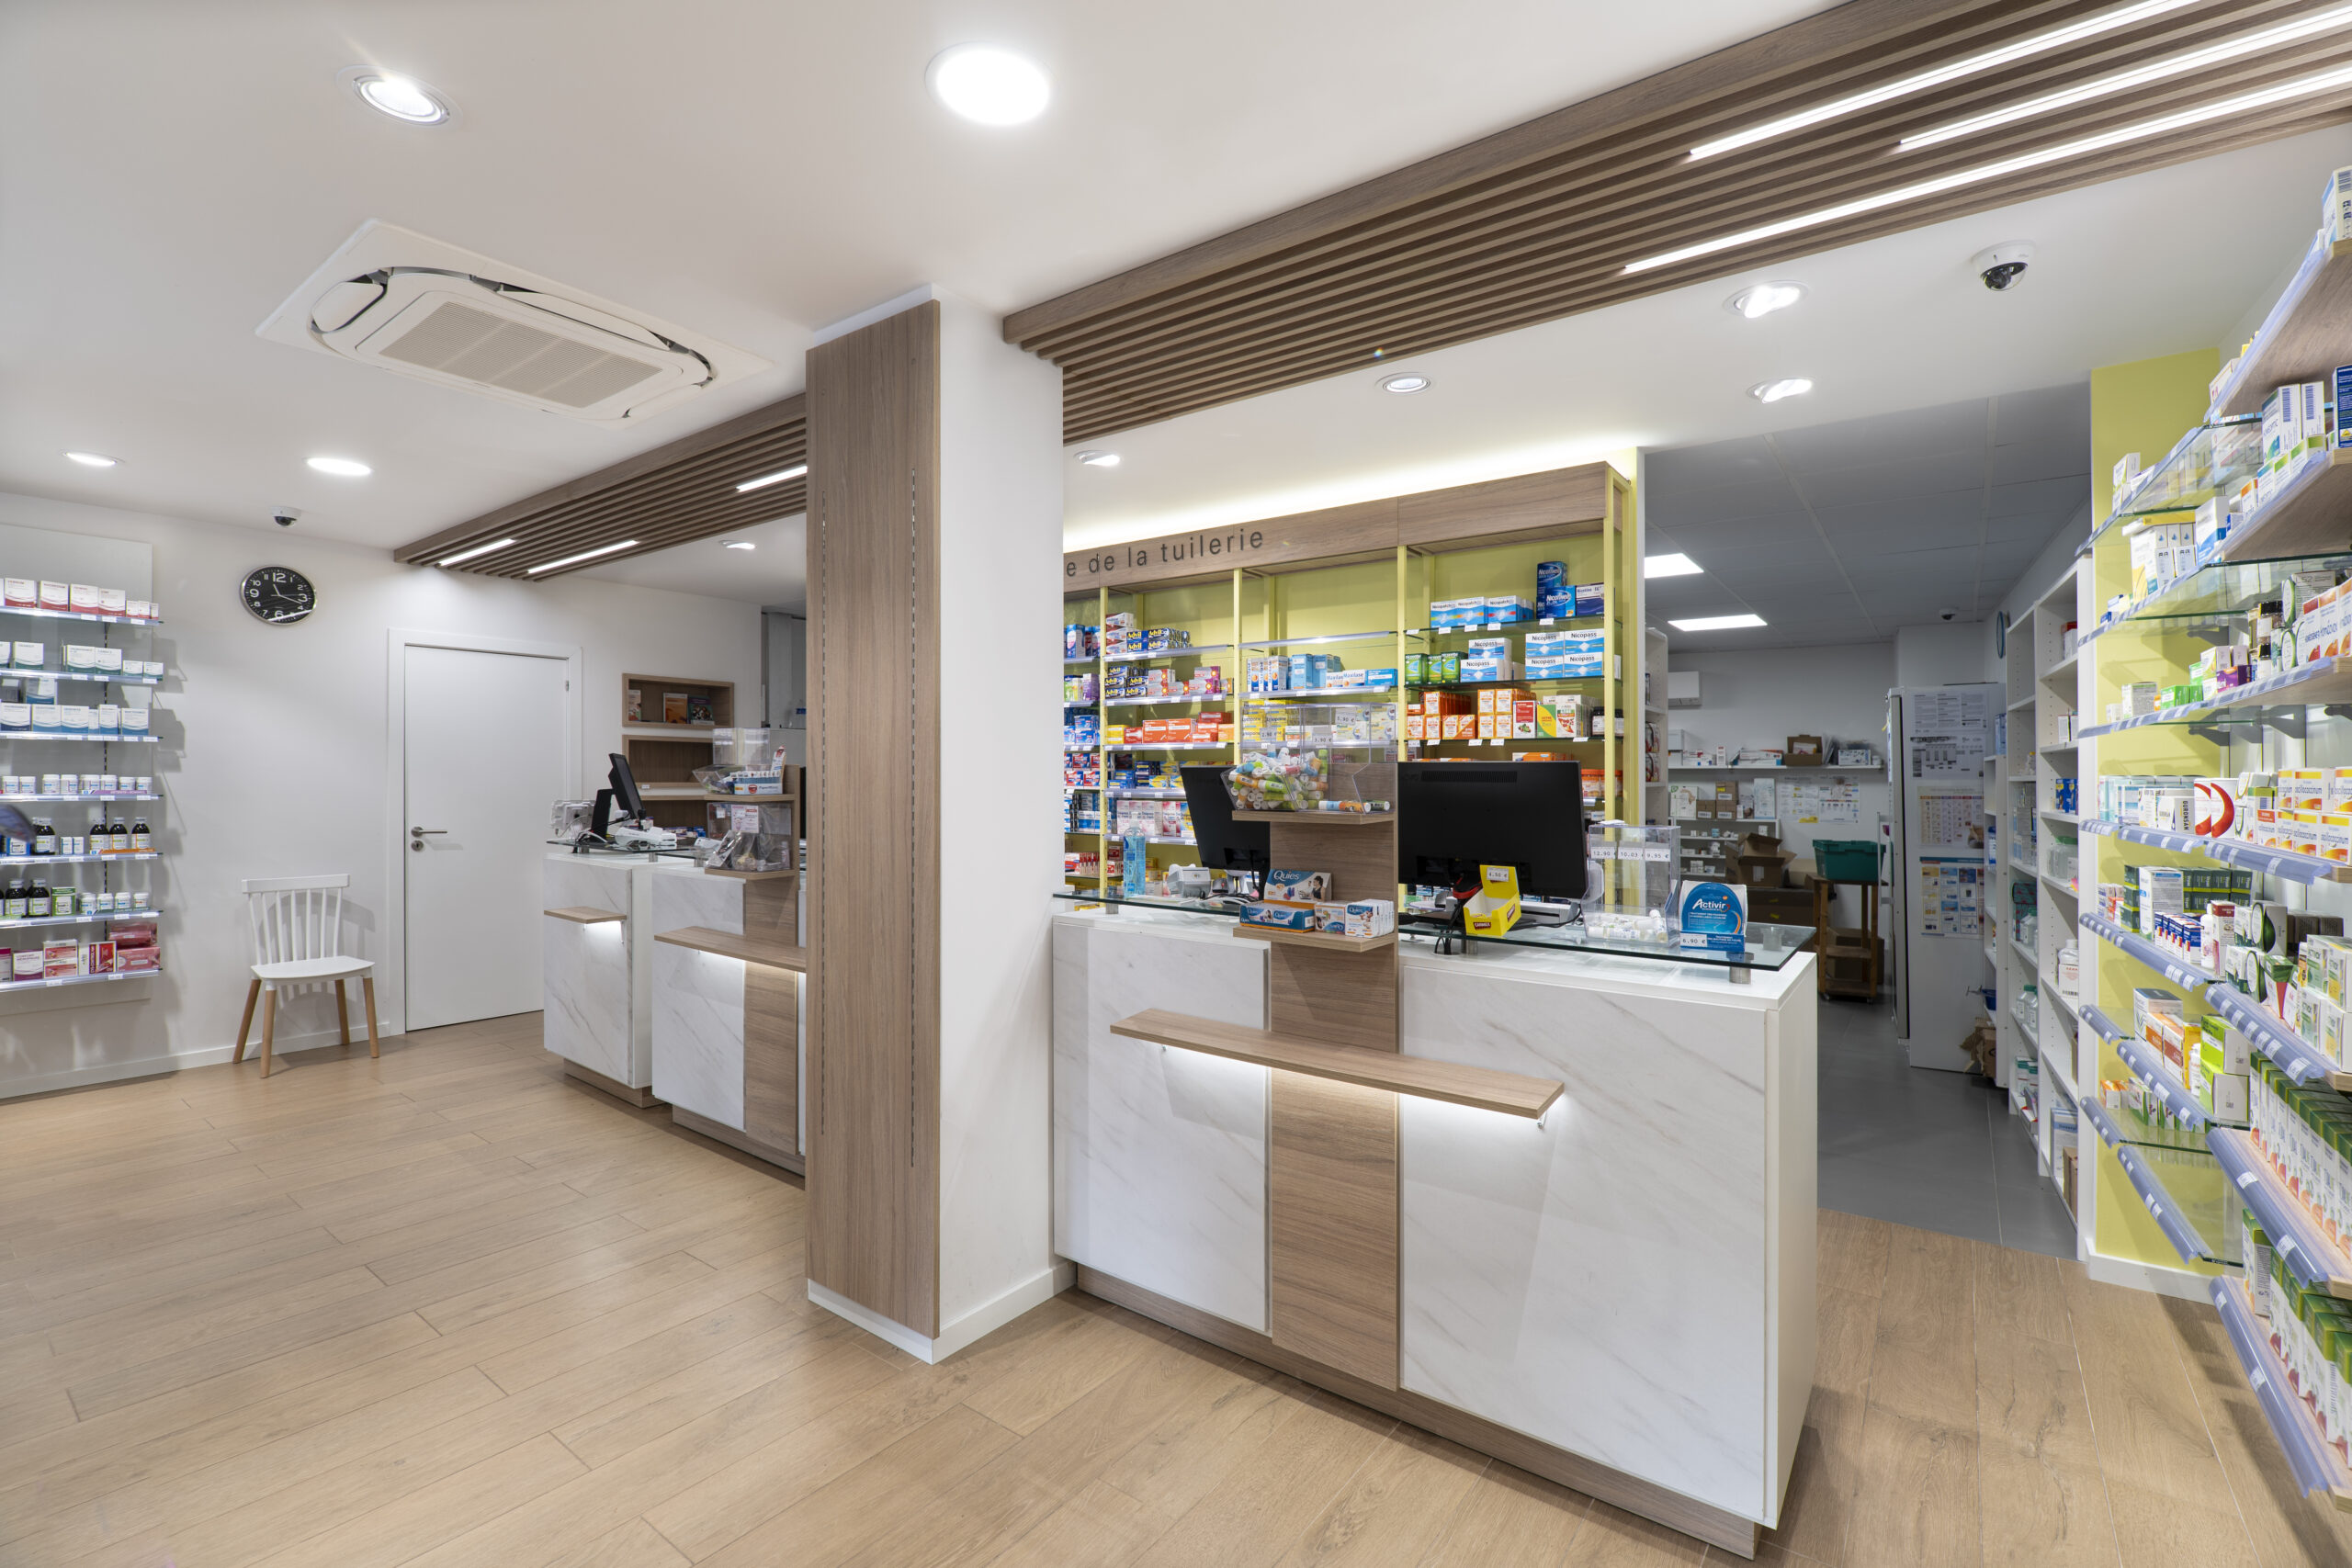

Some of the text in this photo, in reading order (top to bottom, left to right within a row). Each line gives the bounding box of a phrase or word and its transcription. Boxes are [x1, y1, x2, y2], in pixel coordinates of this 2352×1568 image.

[1088, 553, 1115, 574] de
[1127, 547, 1148, 568] la
[1160, 528, 1264, 563] tuilerie
[273, 572, 287, 582] 12
[250, 588, 259, 598] 9
[297, 593, 309, 603] 3
[1532, 634, 1557, 642] Nicopass
[1570, 631, 1598, 639] Nicopass
[1569, 656, 1595, 664] Nicopass
[1273, 870, 1300, 881] Quies
[1691, 898, 1726, 910] Activir
